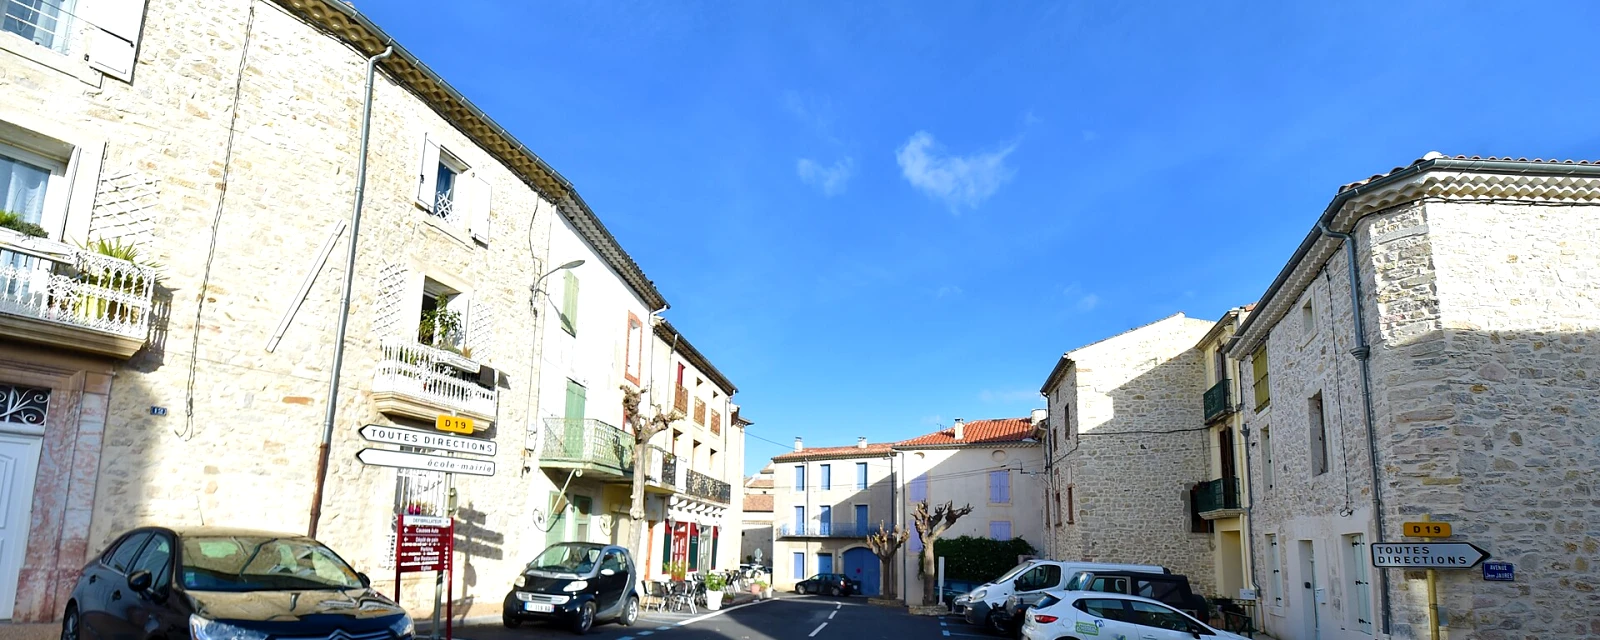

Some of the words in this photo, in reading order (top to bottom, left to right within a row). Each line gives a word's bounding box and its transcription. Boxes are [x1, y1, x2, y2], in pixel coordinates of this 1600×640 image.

[445, 419, 451, 427] D
[454, 420, 466, 429] 19
[371, 429, 418, 442] TOUTES
[424, 436, 492, 452] DIRECTIONS
[1413, 525, 1421, 533] D
[1377, 546, 1430, 554] TOUTES
[1378, 556, 1467, 564] DIRECTIONS
